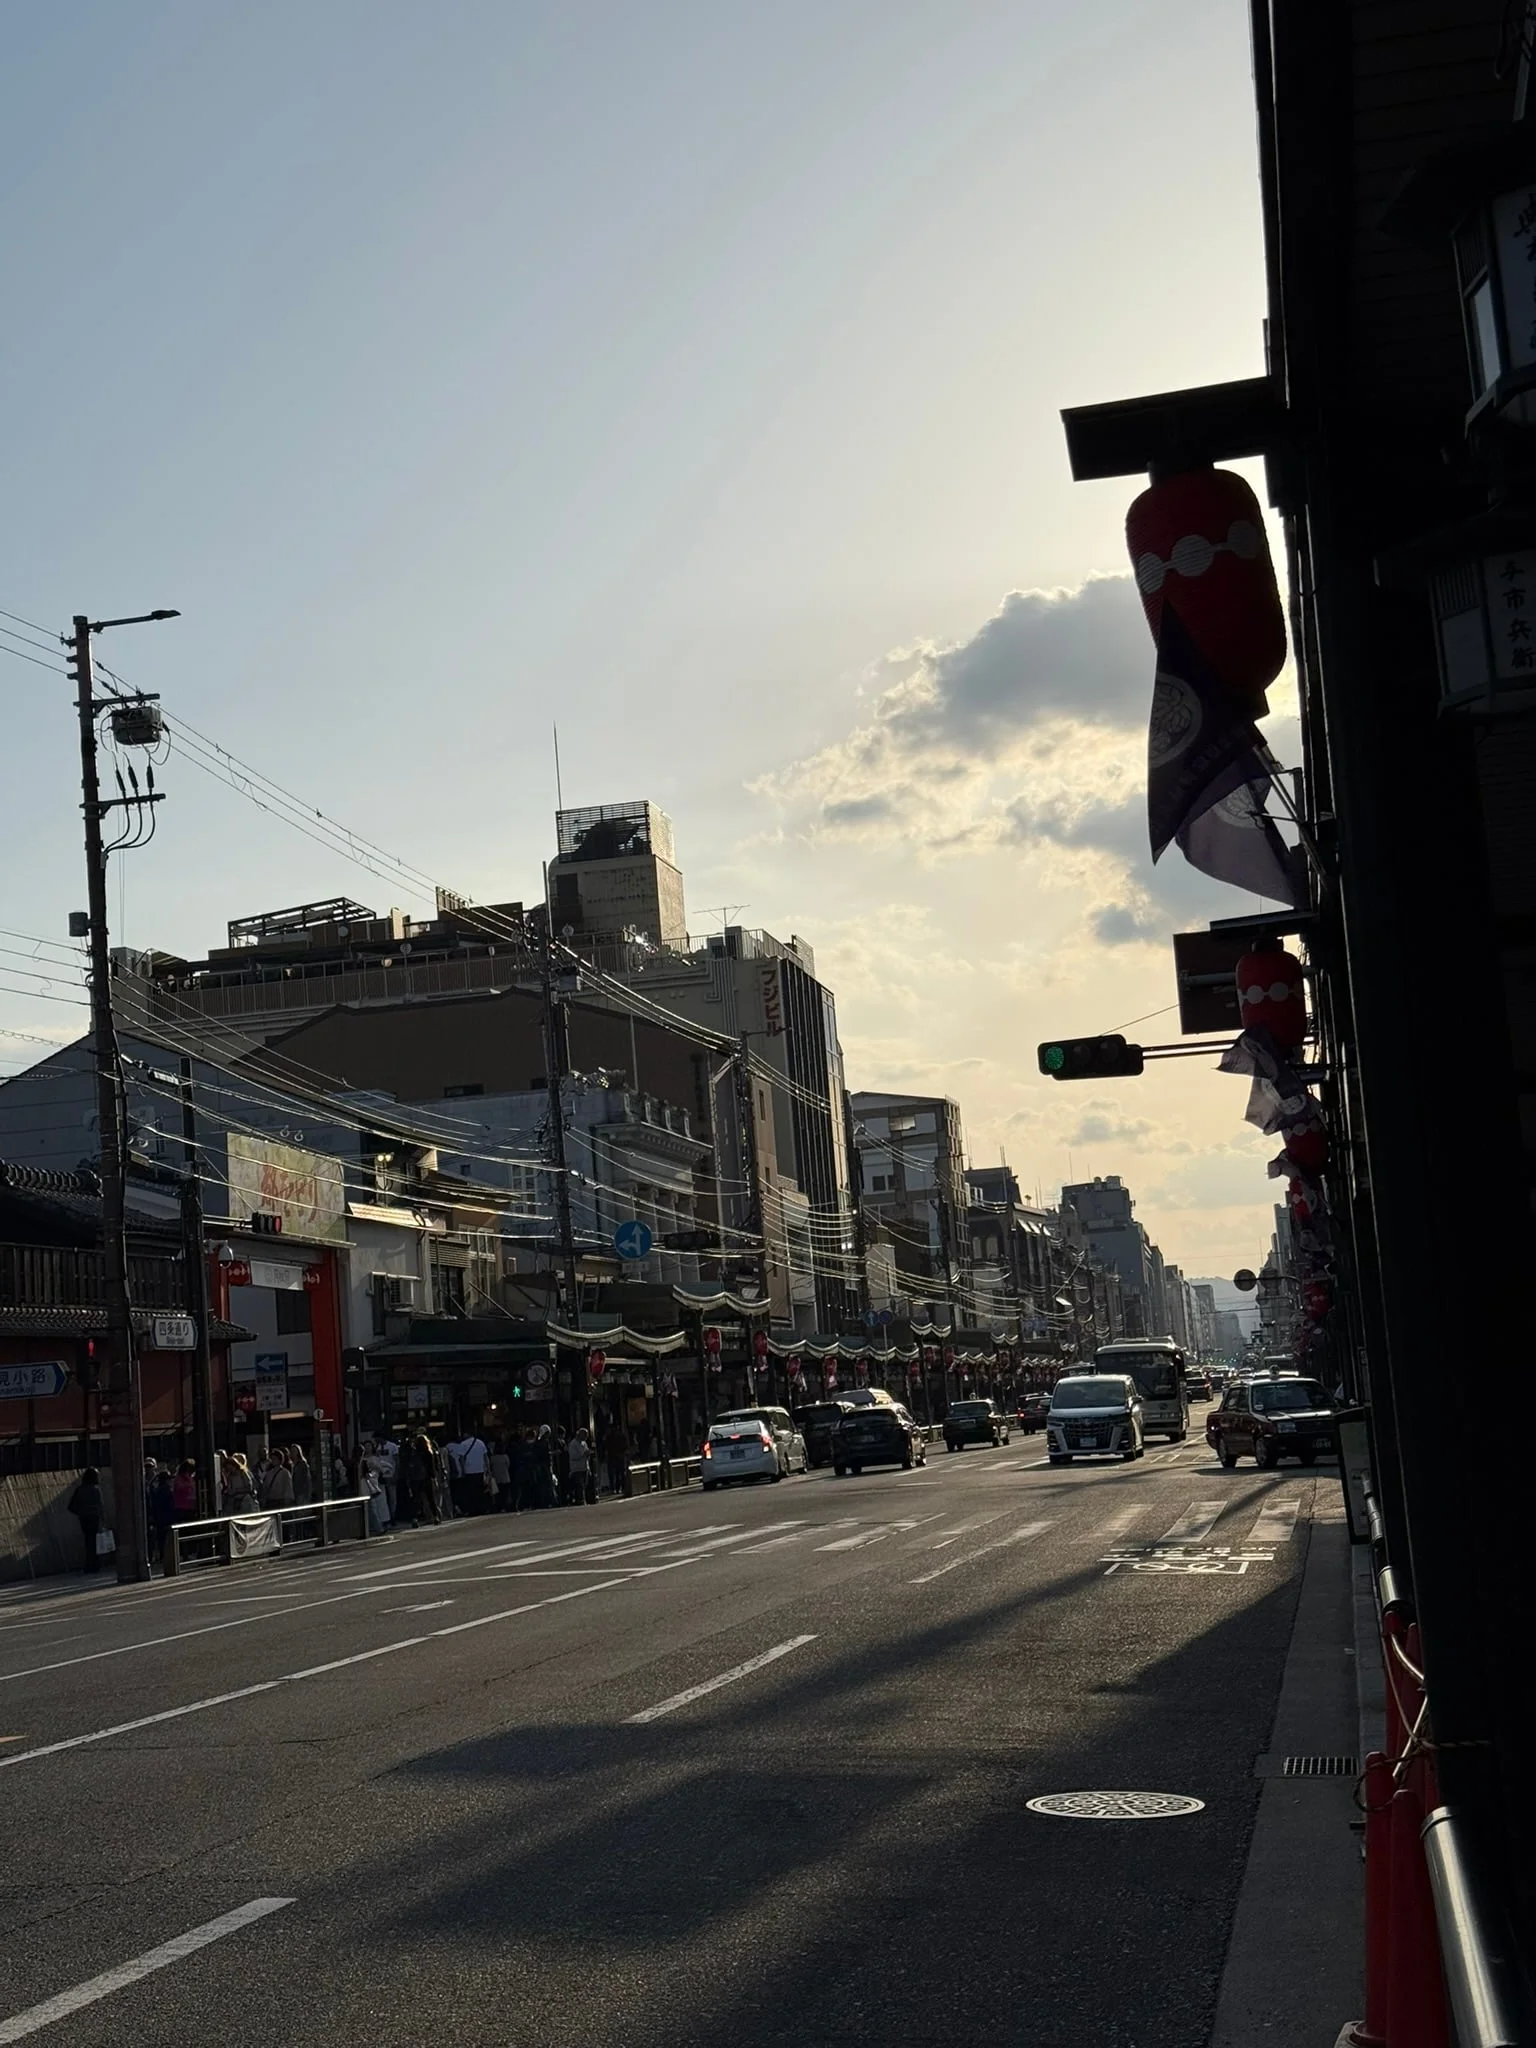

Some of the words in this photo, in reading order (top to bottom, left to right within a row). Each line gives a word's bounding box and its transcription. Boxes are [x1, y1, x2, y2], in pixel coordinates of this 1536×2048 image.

[761, 969, 780, 1037] フジビル
[159, 1321, 189, 1336] 四条通り
